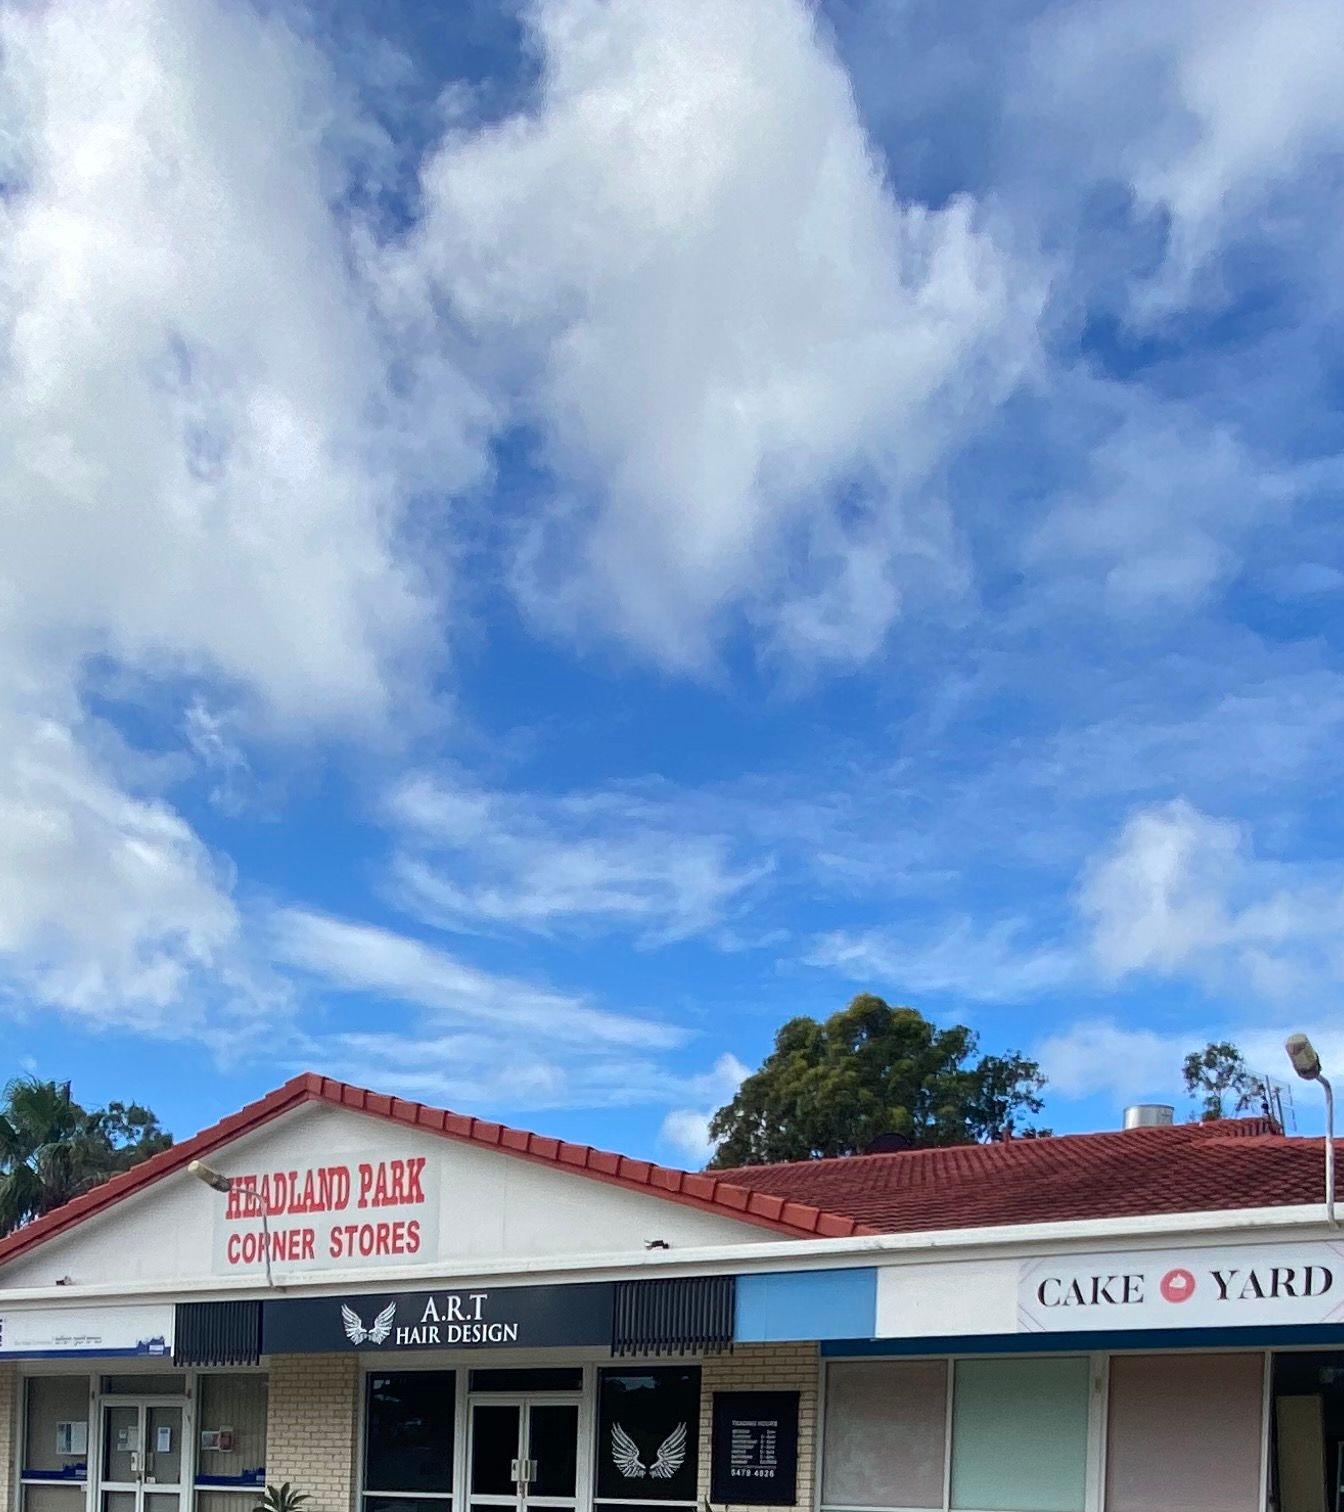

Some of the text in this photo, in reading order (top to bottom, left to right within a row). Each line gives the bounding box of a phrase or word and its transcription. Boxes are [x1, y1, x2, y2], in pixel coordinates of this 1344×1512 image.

[226, 1158, 426, 1219] HEADLAND PARK
[228, 1220, 420, 1264] CORNER STORES
[1037, 1265, 1334, 1307] CAKE YARD
[421, 1294, 488, 1323] A.R.T
[396, 1323, 518, 1345] HAIR DESIGN
